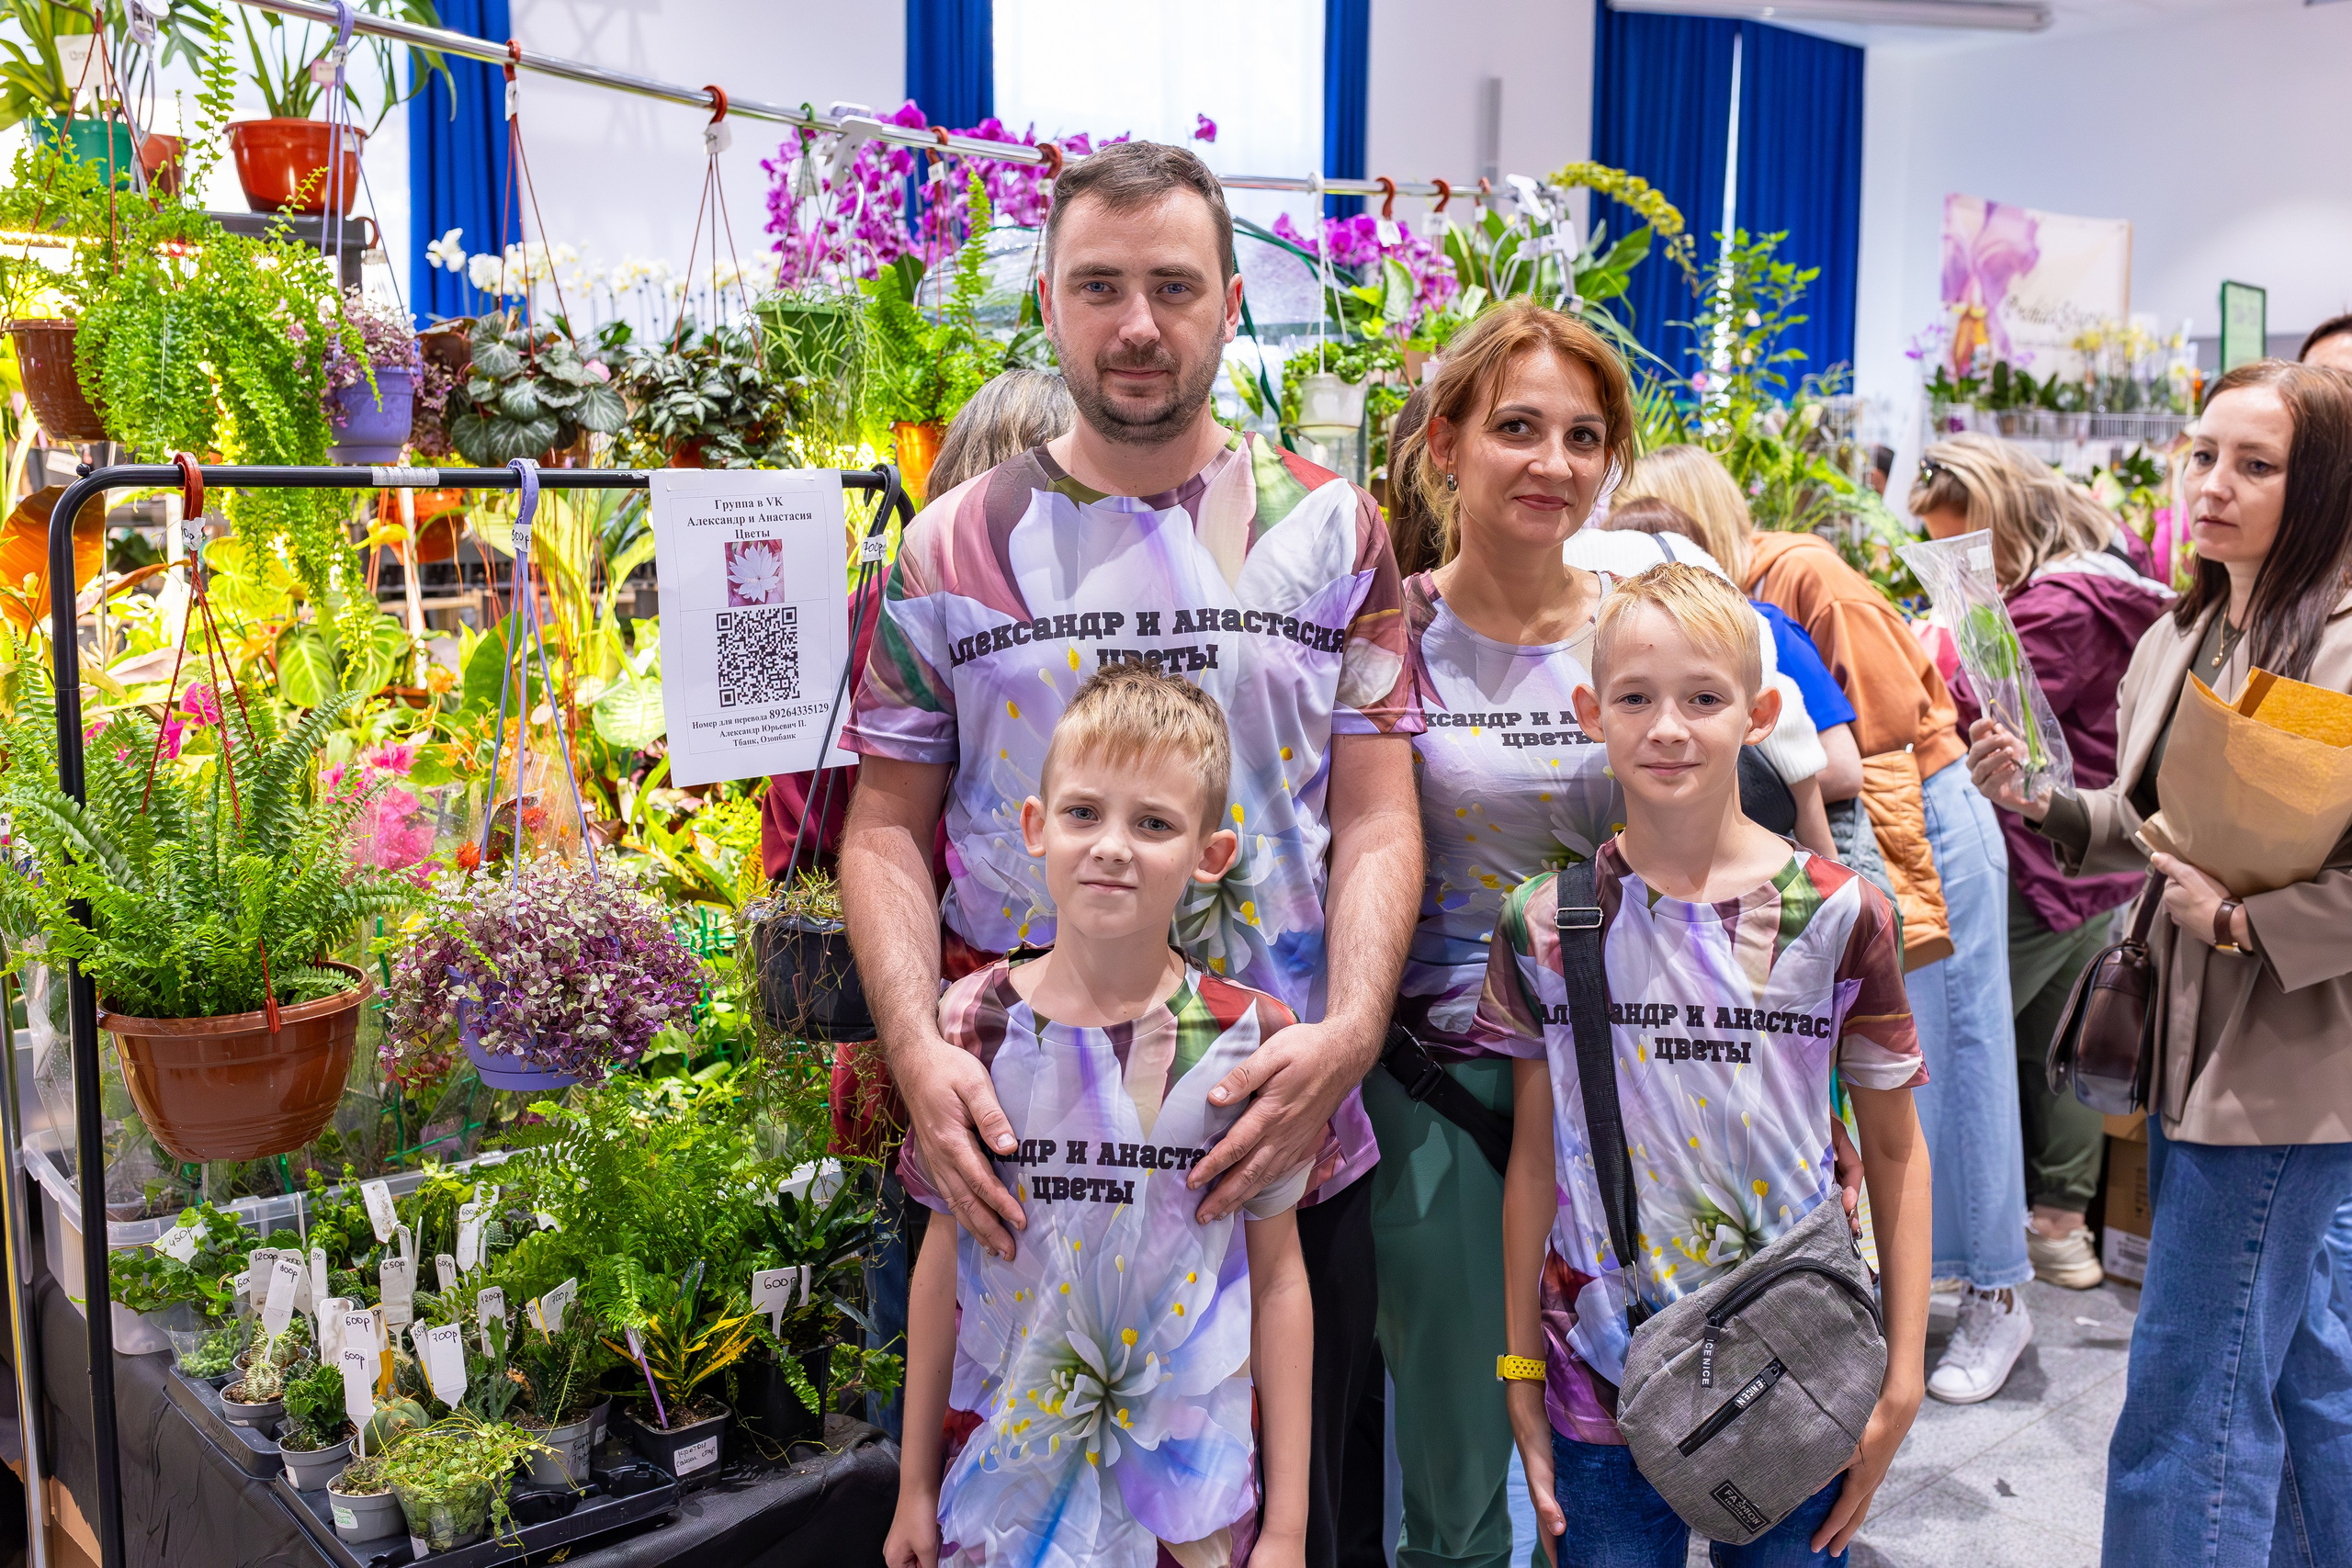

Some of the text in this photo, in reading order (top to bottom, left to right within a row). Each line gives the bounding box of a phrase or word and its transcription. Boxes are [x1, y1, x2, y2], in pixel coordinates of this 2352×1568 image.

[715, 497, 784, 512] Группа в VK
[687, 512, 812, 527] Александр и Анастасия
[735, 529, 770, 540] Цветы
[692, 702, 830, 729] Номер для перевода 89264335129
[719, 728, 760, 738] Александр
[762, 723, 797, 733] Юрьевич
[760, 733, 797, 743] Озонбанк
[1713, 1007, 1832, 1039] Анастас
[1724, 1489, 1760, 1525] FASHION
